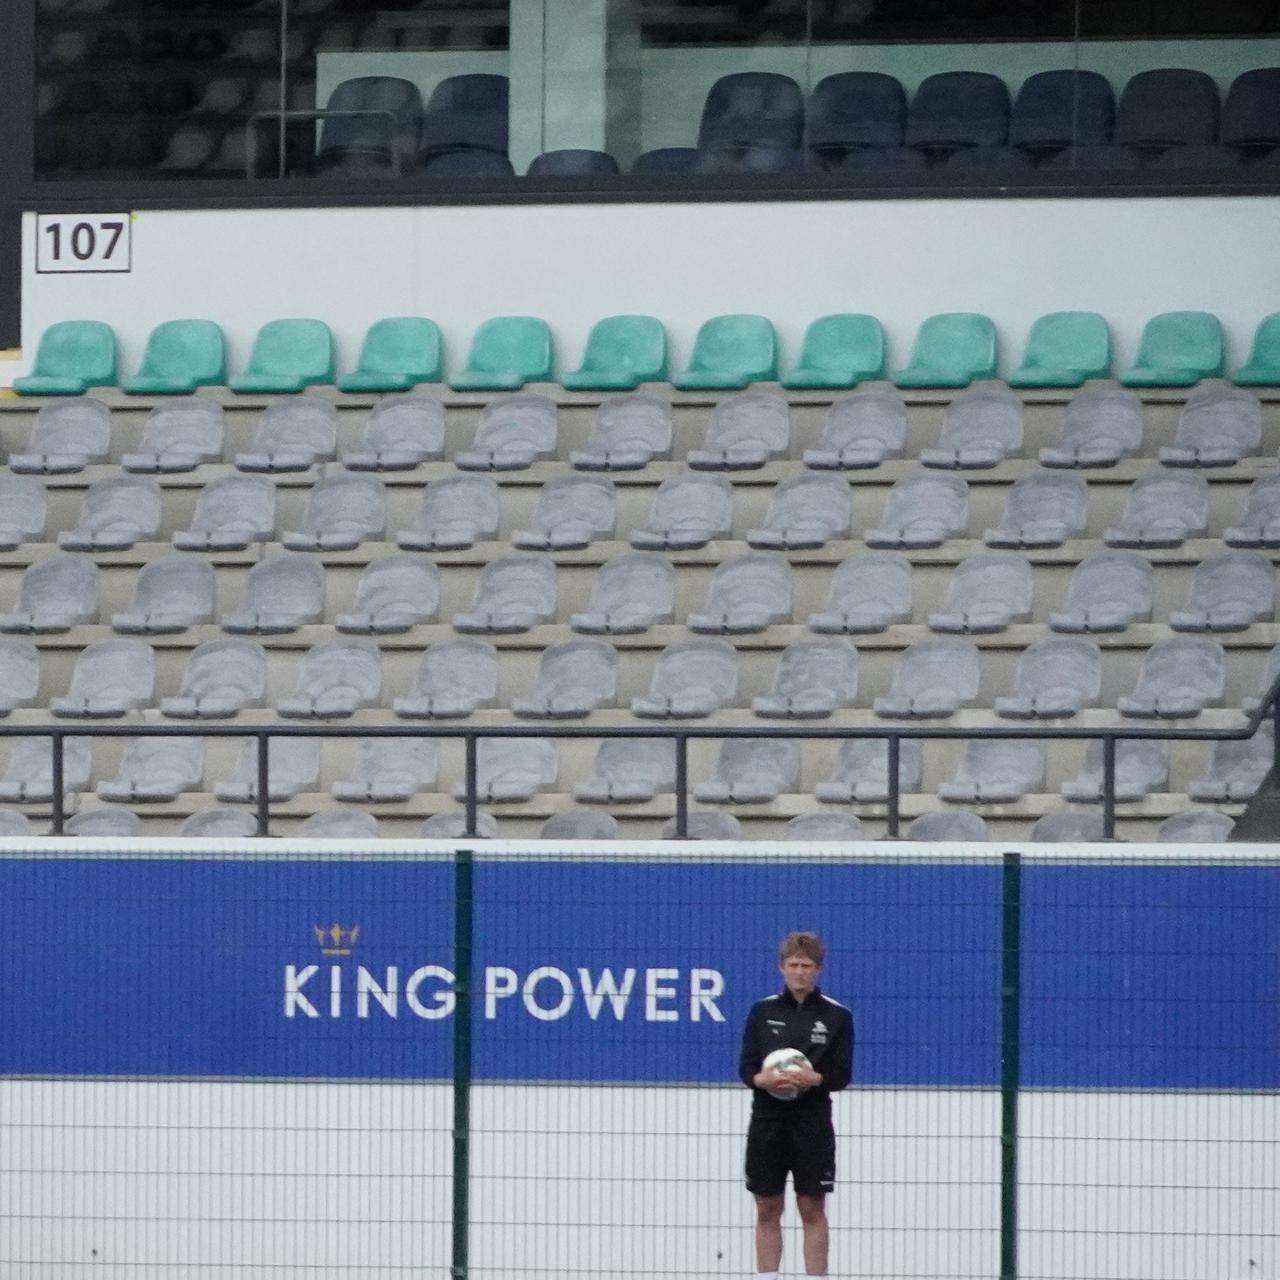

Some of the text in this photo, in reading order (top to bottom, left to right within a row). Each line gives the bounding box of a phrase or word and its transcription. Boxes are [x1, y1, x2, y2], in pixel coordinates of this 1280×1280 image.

[46, 222, 124, 261] 107
[284, 964, 727, 1021] KING POWER
